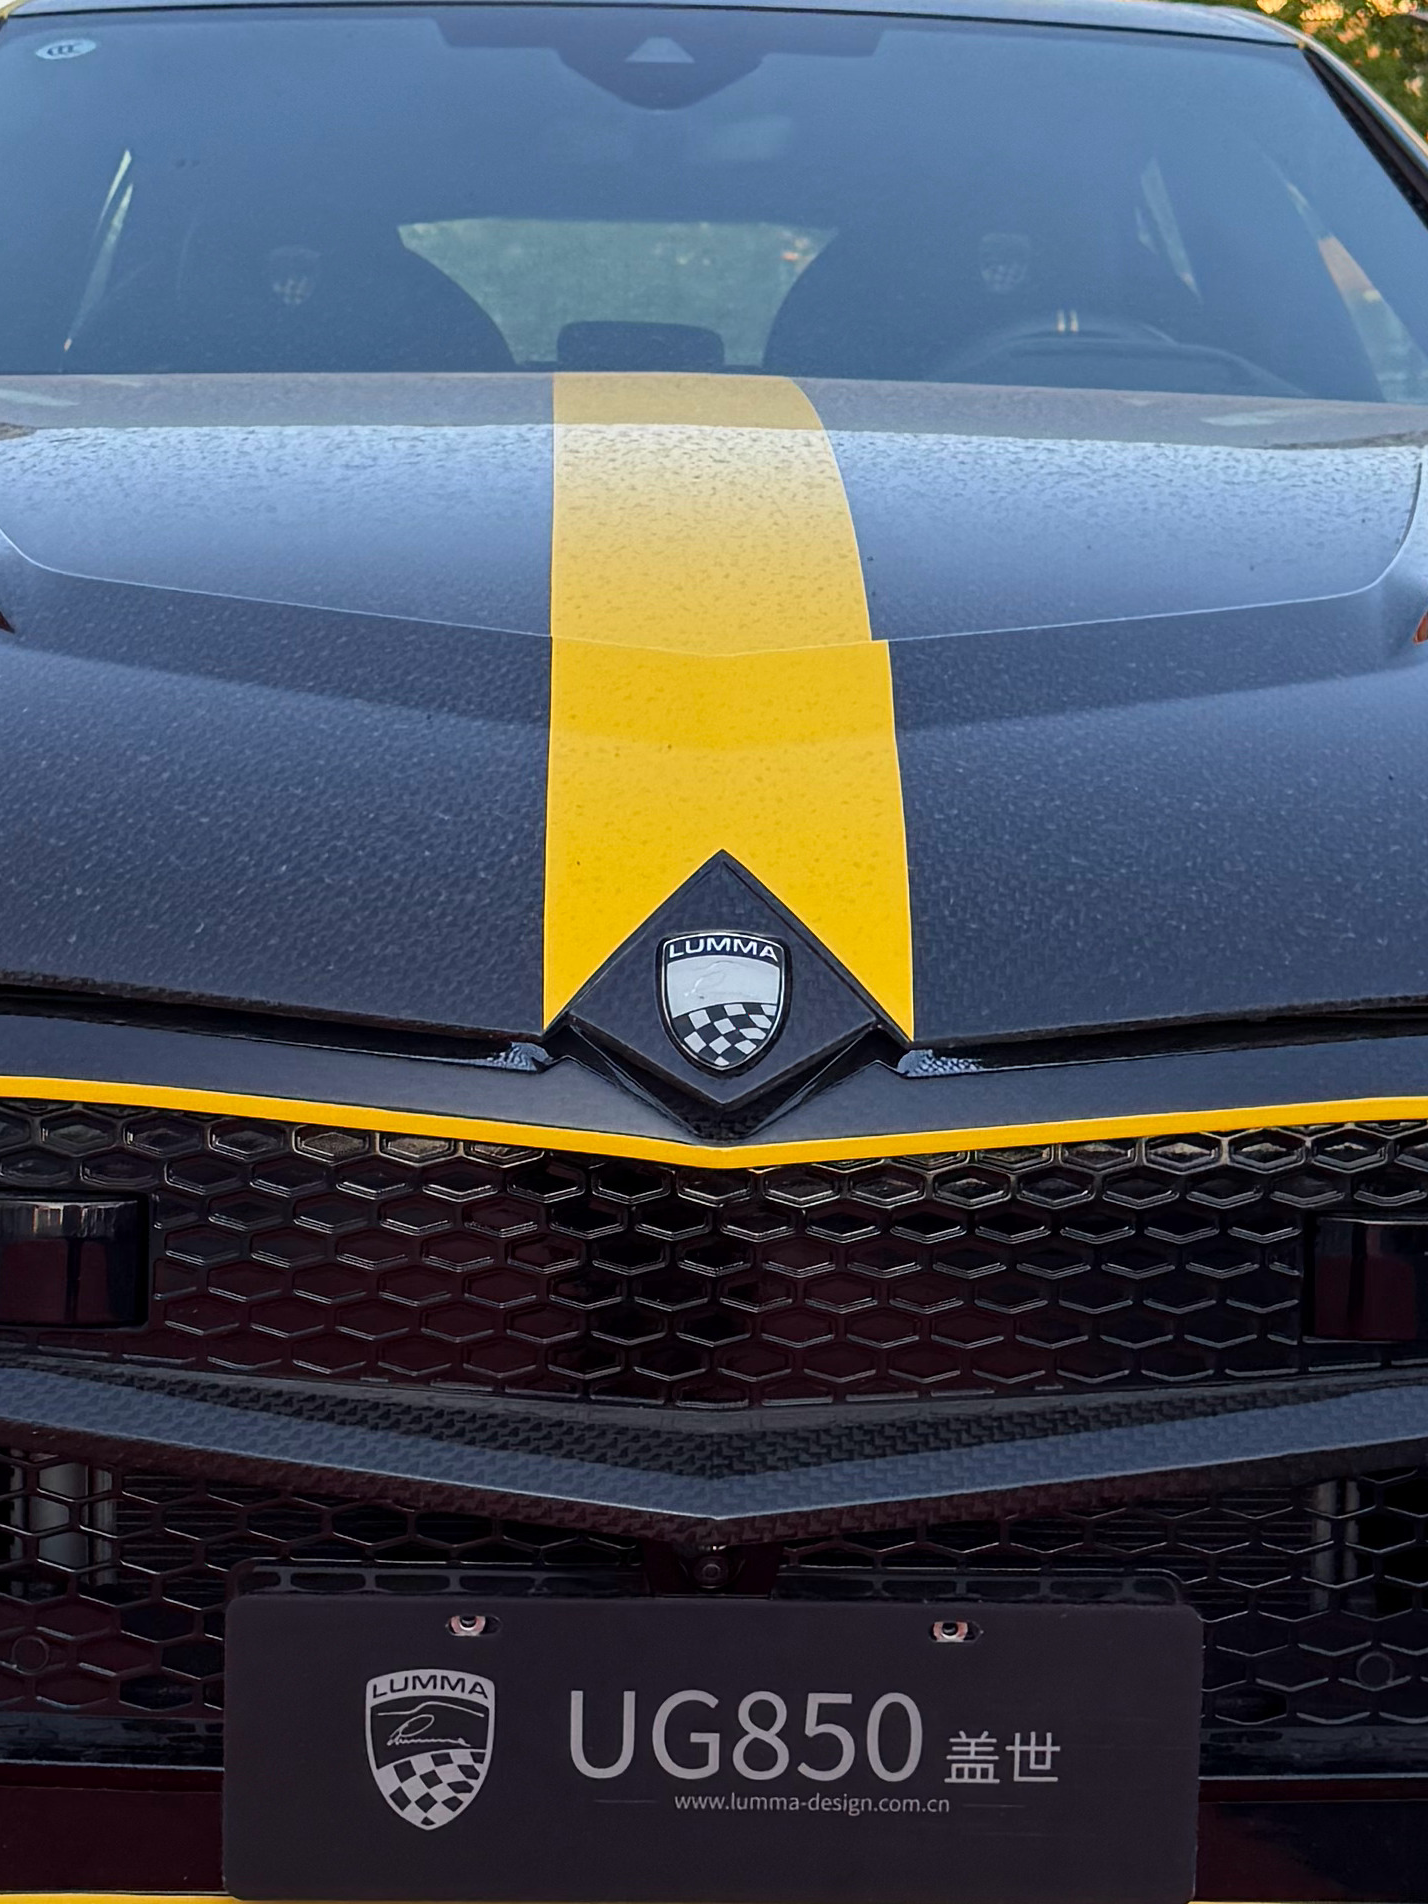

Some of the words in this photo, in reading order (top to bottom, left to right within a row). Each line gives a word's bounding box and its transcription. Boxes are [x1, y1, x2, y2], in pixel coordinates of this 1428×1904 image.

[668, 937, 779, 962] LUMMA
[373, 1674, 489, 1700] LUMMA
[570, 1688, 923, 1783] UG850
[943, 1730, 1062, 1784] 盖世
[674, 1792, 951, 1817] www.lumma-design.com.cn
